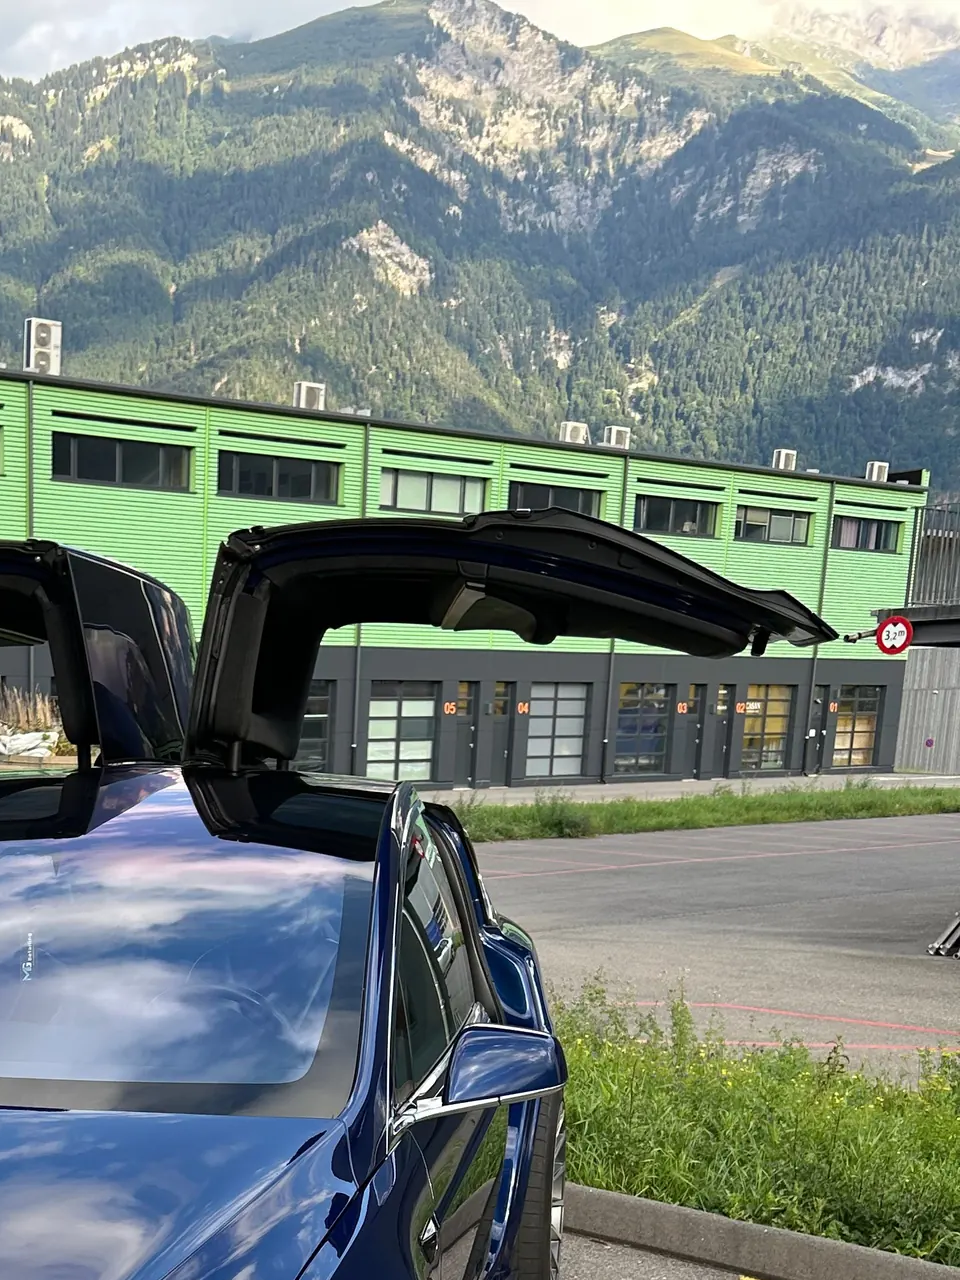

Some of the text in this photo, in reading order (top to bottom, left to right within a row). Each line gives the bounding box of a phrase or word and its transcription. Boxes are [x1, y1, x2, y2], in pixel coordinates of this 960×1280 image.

[443, 702, 457, 715] 05
[517, 702, 529, 715] 04
[677, 702, 688, 714] 03
[736, 702, 746, 714] 02
[829, 702, 838, 713] 01
